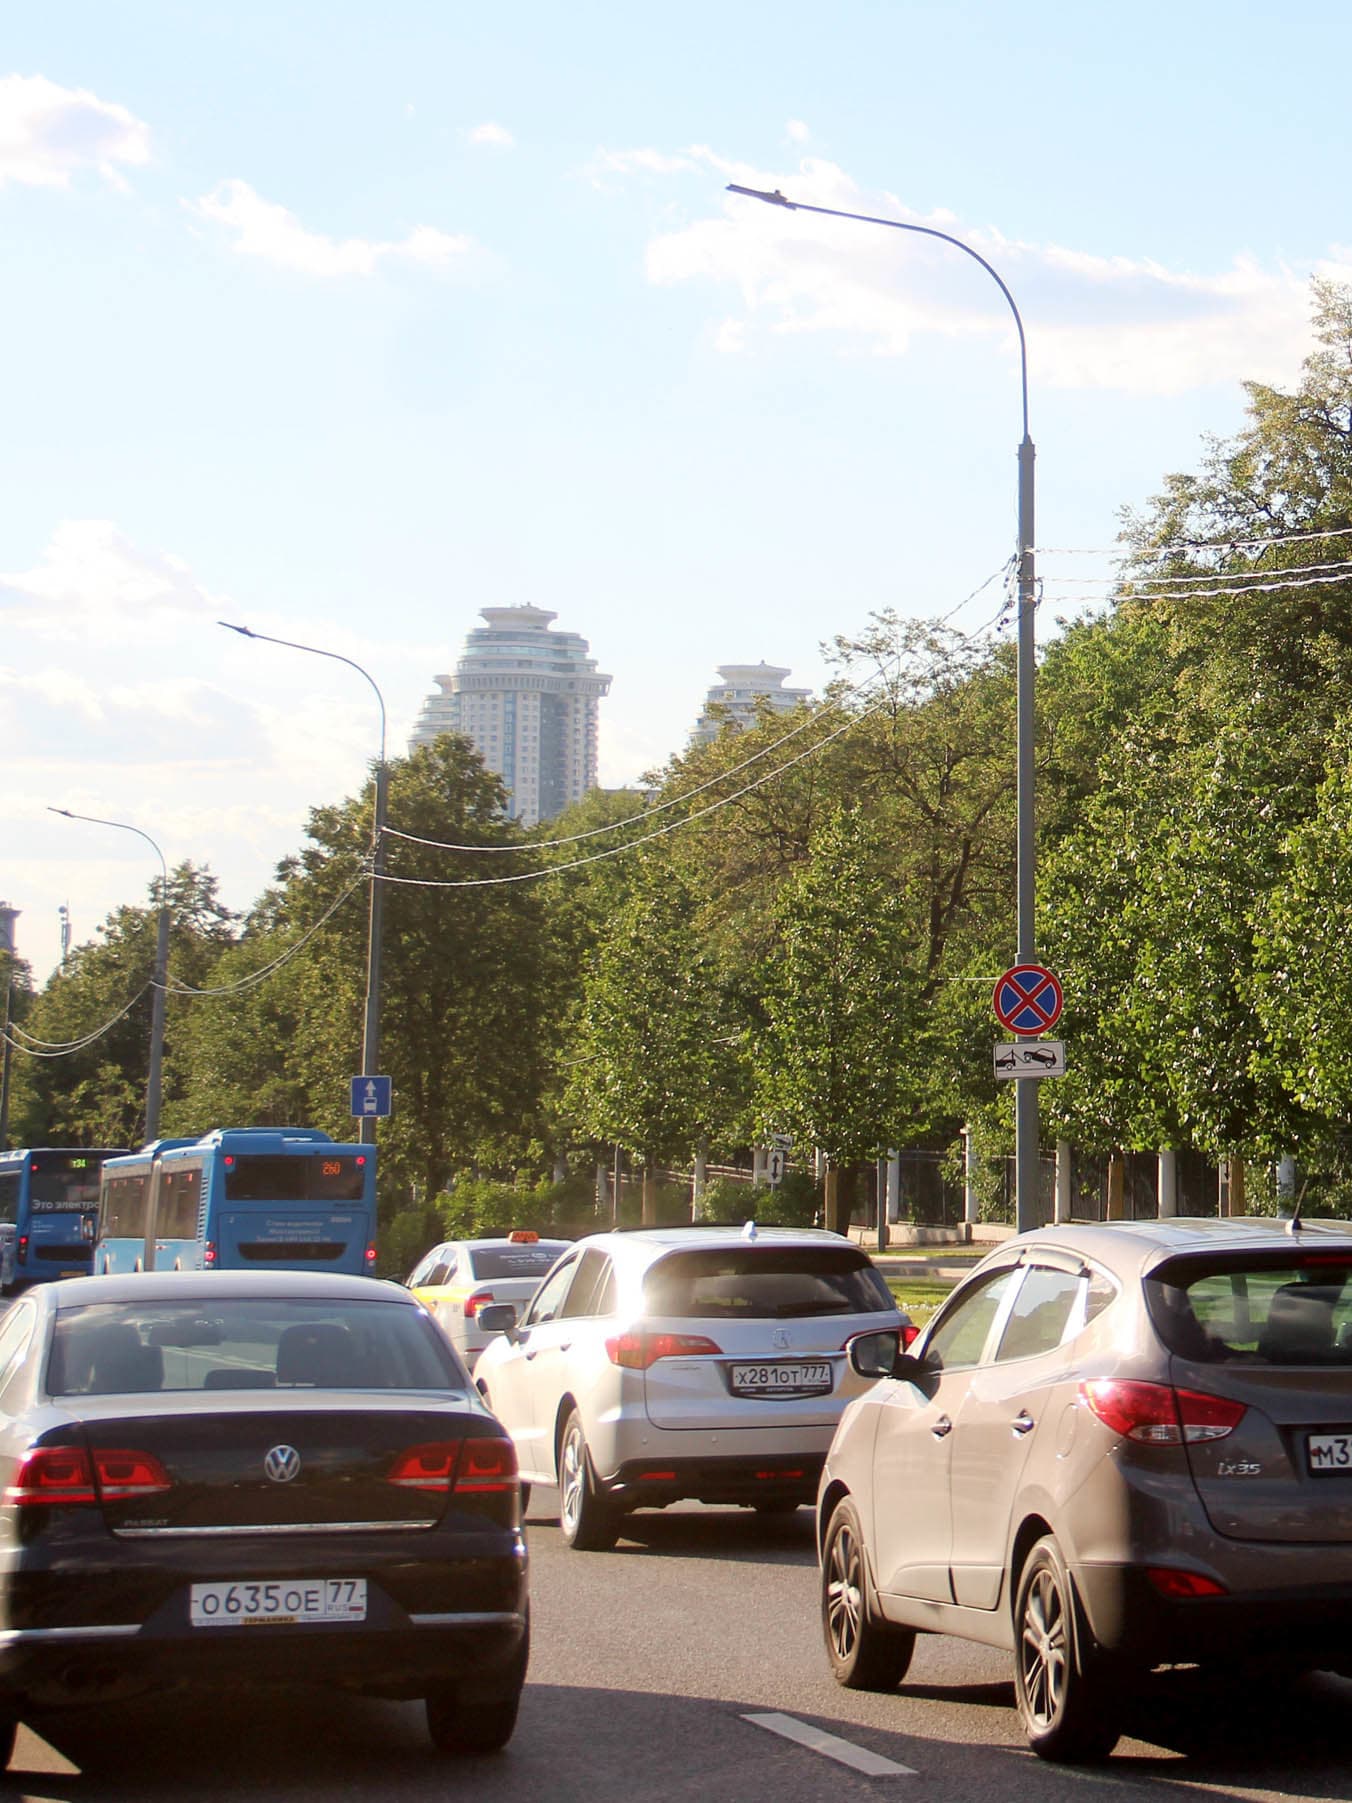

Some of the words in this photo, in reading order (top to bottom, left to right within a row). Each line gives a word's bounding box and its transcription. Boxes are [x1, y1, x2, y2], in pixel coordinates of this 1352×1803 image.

[321, 1162, 342, 1176] 260
[32, 1200, 53, 1210] Это
[802, 1366, 826, 1379] 777
[202, 1584, 320, 1615] О635ОЕ
[328, 1581, 357, 1603] 77
[327, 1604, 349, 1612] RUS
